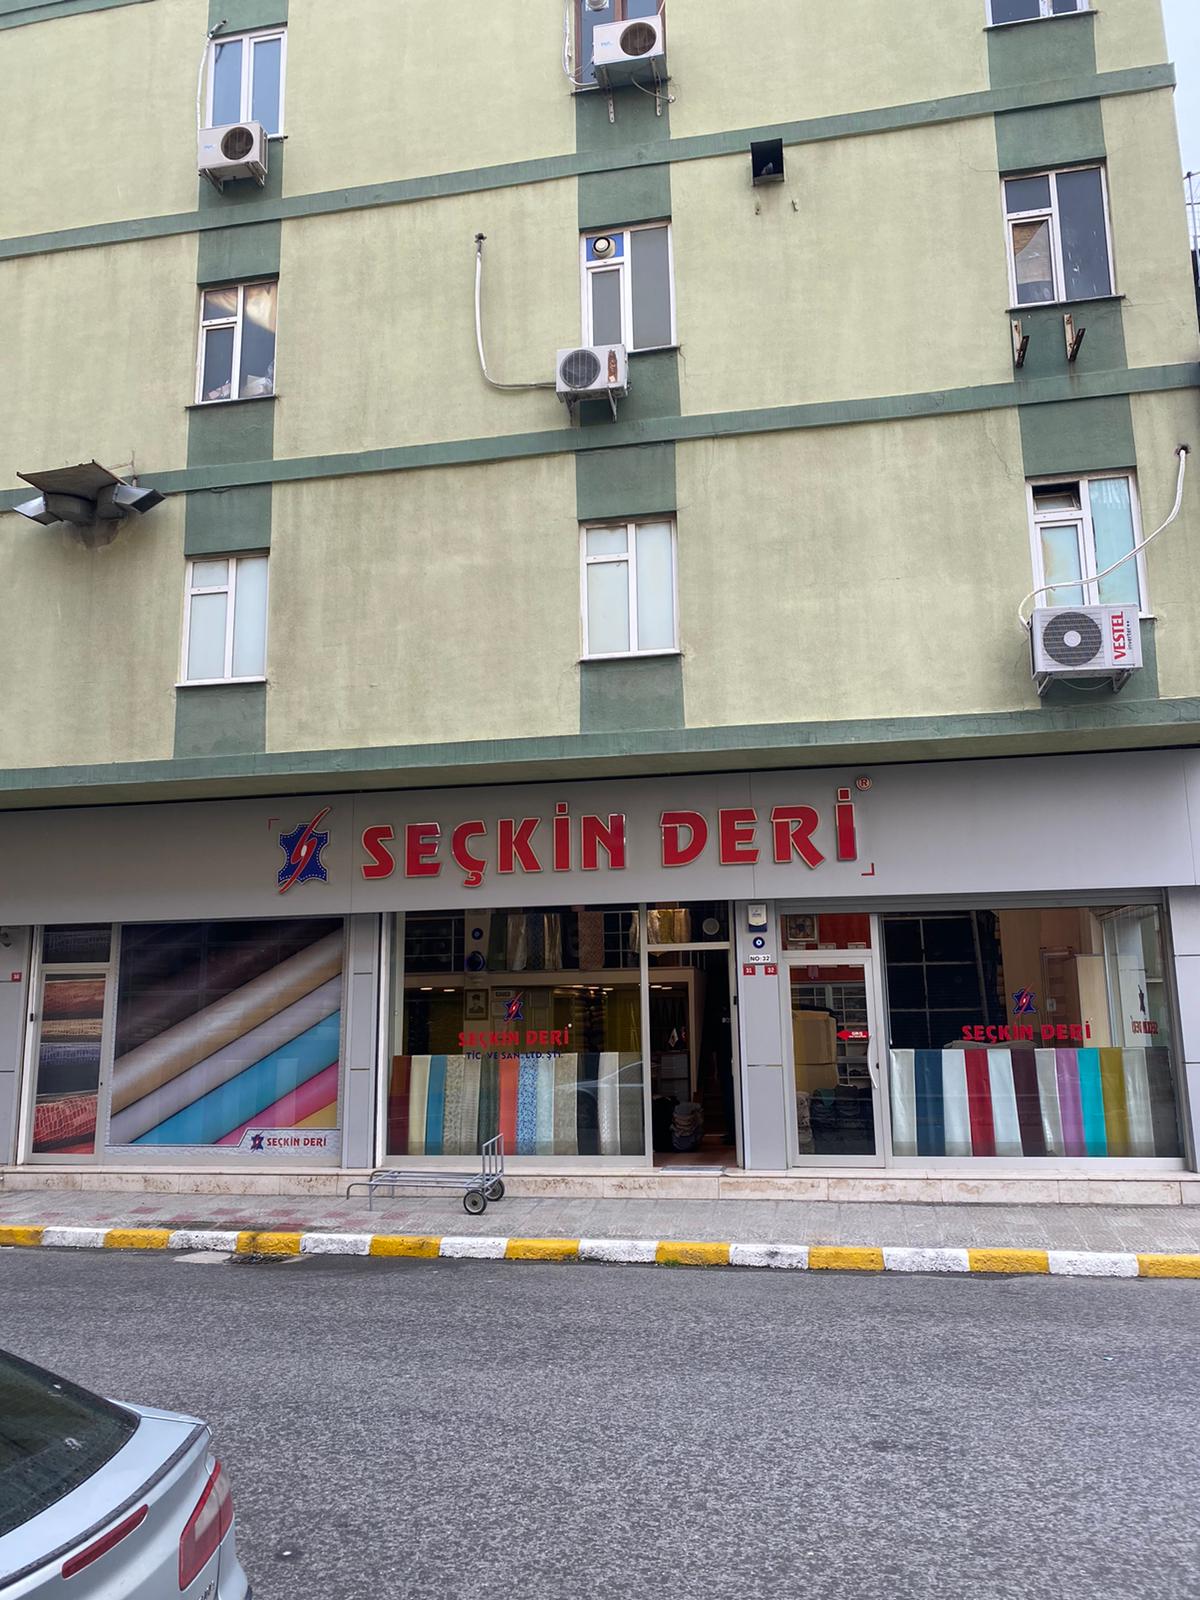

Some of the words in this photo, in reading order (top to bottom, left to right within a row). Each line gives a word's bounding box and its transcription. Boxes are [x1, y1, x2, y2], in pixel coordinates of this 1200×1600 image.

[1111, 611, 1127, 660] VESTEL
[361, 801, 627, 888] SEÇKİN
[659, 787, 858, 870] DERİ
[526, 1026, 569, 1046] DERİ
[961, 1021, 1034, 1044] SEÇKİN
[1041, 1020, 1091, 1041] DERİ
[487, 1051, 499, 1060] VE
[266, 1136, 300, 1148] SEÇKİN
[303, 1135, 327, 1148] DERİ
